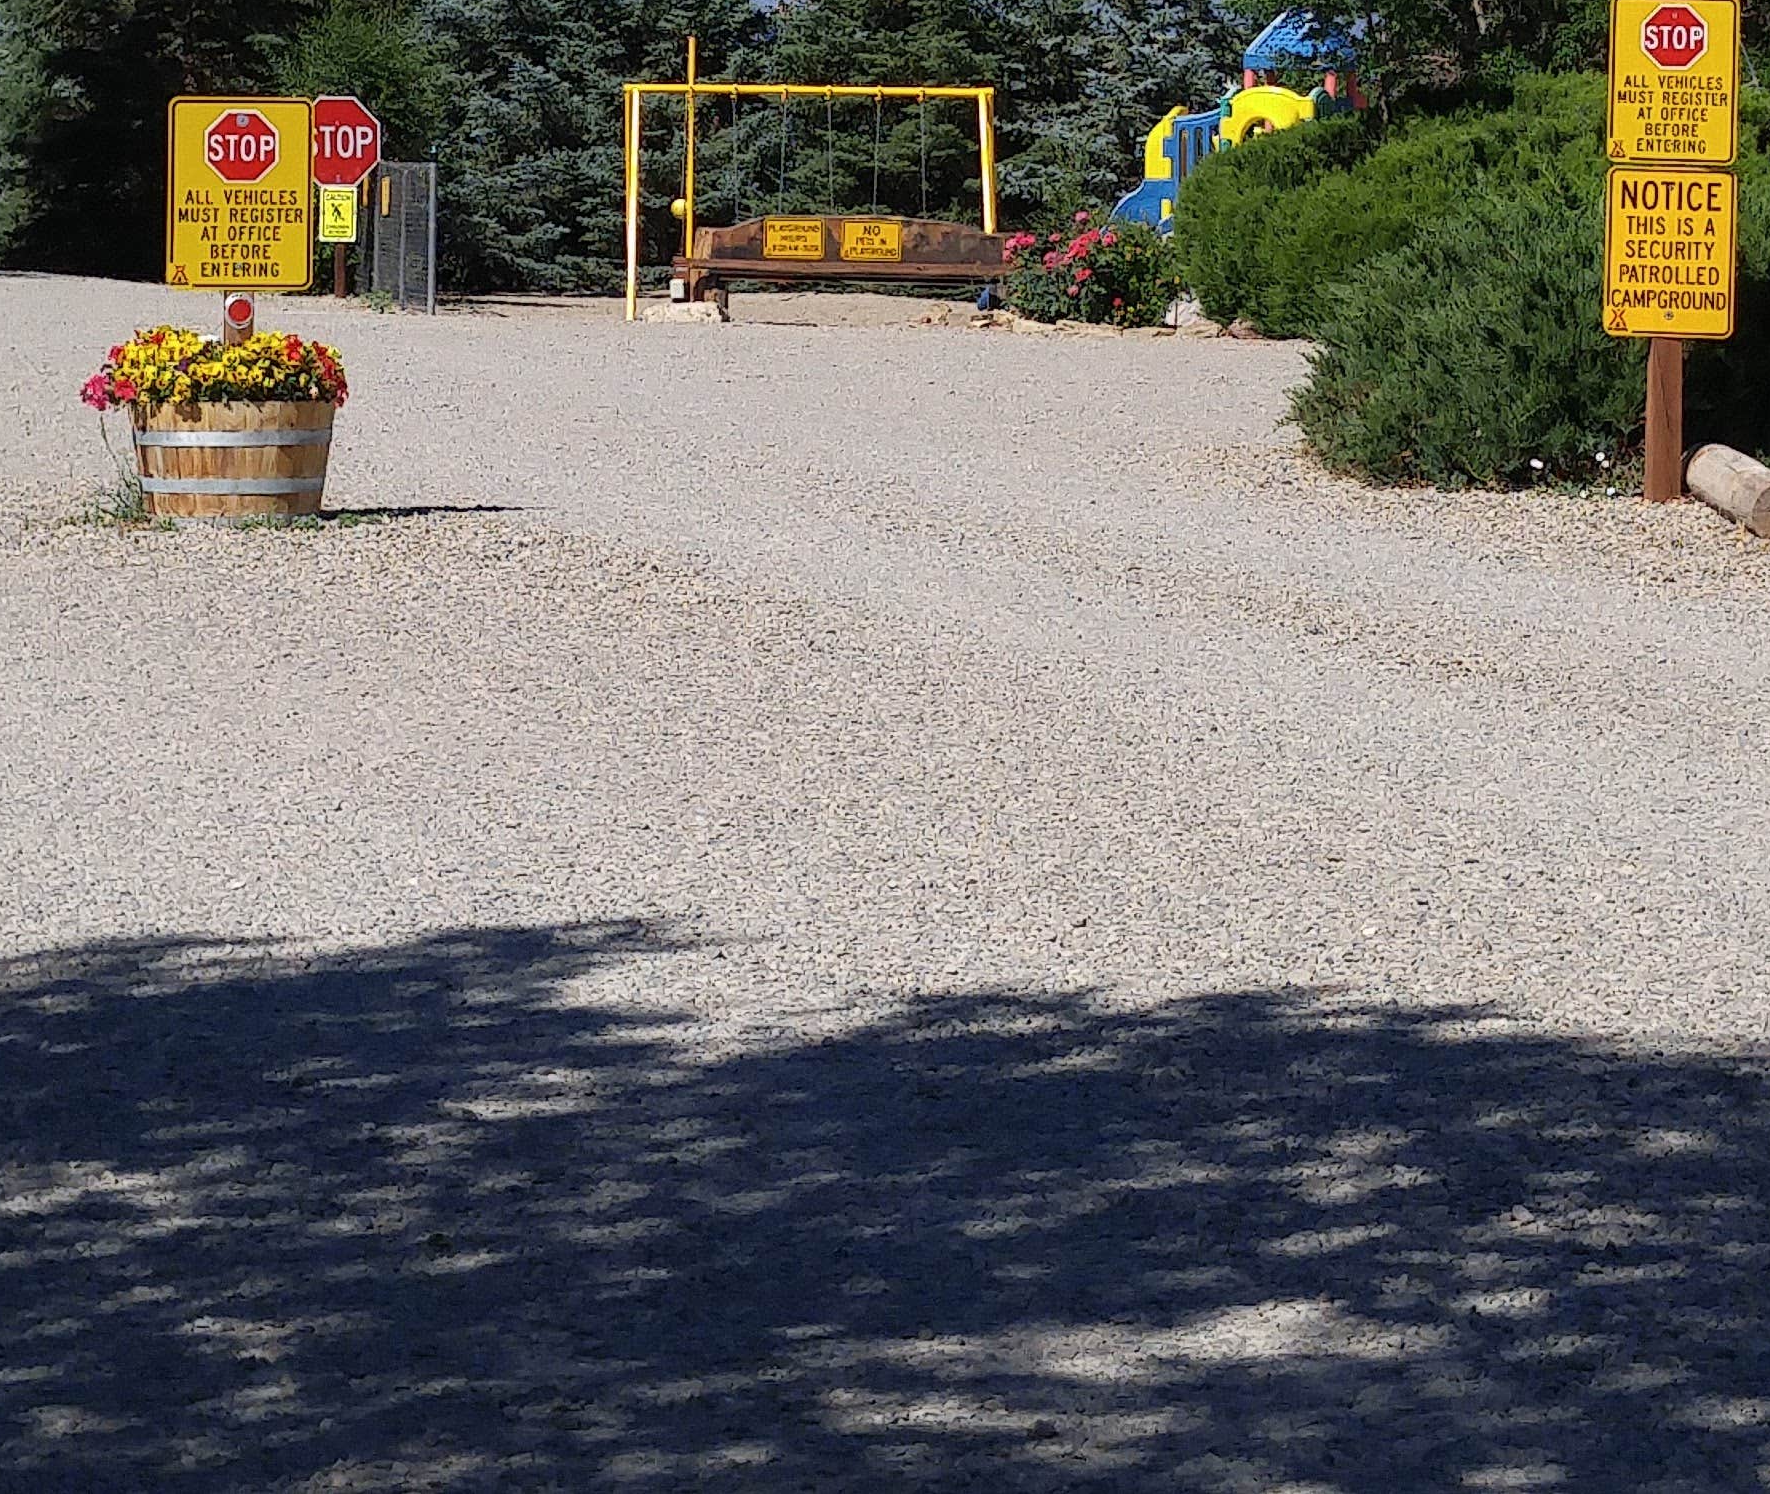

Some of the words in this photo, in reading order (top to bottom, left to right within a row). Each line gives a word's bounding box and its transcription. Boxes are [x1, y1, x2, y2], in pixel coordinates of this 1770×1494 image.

[1644, 25, 1704, 50] STOP
[1624, 76, 1649, 88] ALL
[1657, 76, 1723, 91] VEHICLES
[1617, 91, 1653, 103] MUST
[1662, 92, 1728, 106] REGISTER
[1637, 108, 1652, 120] AT
[1661, 108, 1709, 122] OFFICE
[1645, 124, 1699, 136] BEFORE
[208, 134, 275, 162] STOP
[1636, 139, 1706, 153] ENTERING
[185, 190, 214, 206] ALL
[224, 190, 298, 206] VEHICLES
[1620, 180, 1722, 211] NOTICE
[178, 208, 219, 224] MUST
[229, 208, 303, 223] REGISTER
[200, 226, 220, 241] AT
[228, 226, 281, 241] OFFICE
[862, 225, 881, 236] NO
[1626, 216, 1666, 236] THIS
[1677, 217, 1694, 236] IS
[1704, 218, 1716, 236] A
[210, 243, 271, 260] BEFORE
[1625, 241, 1715, 260] SECURITY
[200, 262, 280, 278] ENTERING
[1619, 264, 1720, 286] PATROLLED
[1610, 289, 1727, 311] CAMPGROUND
